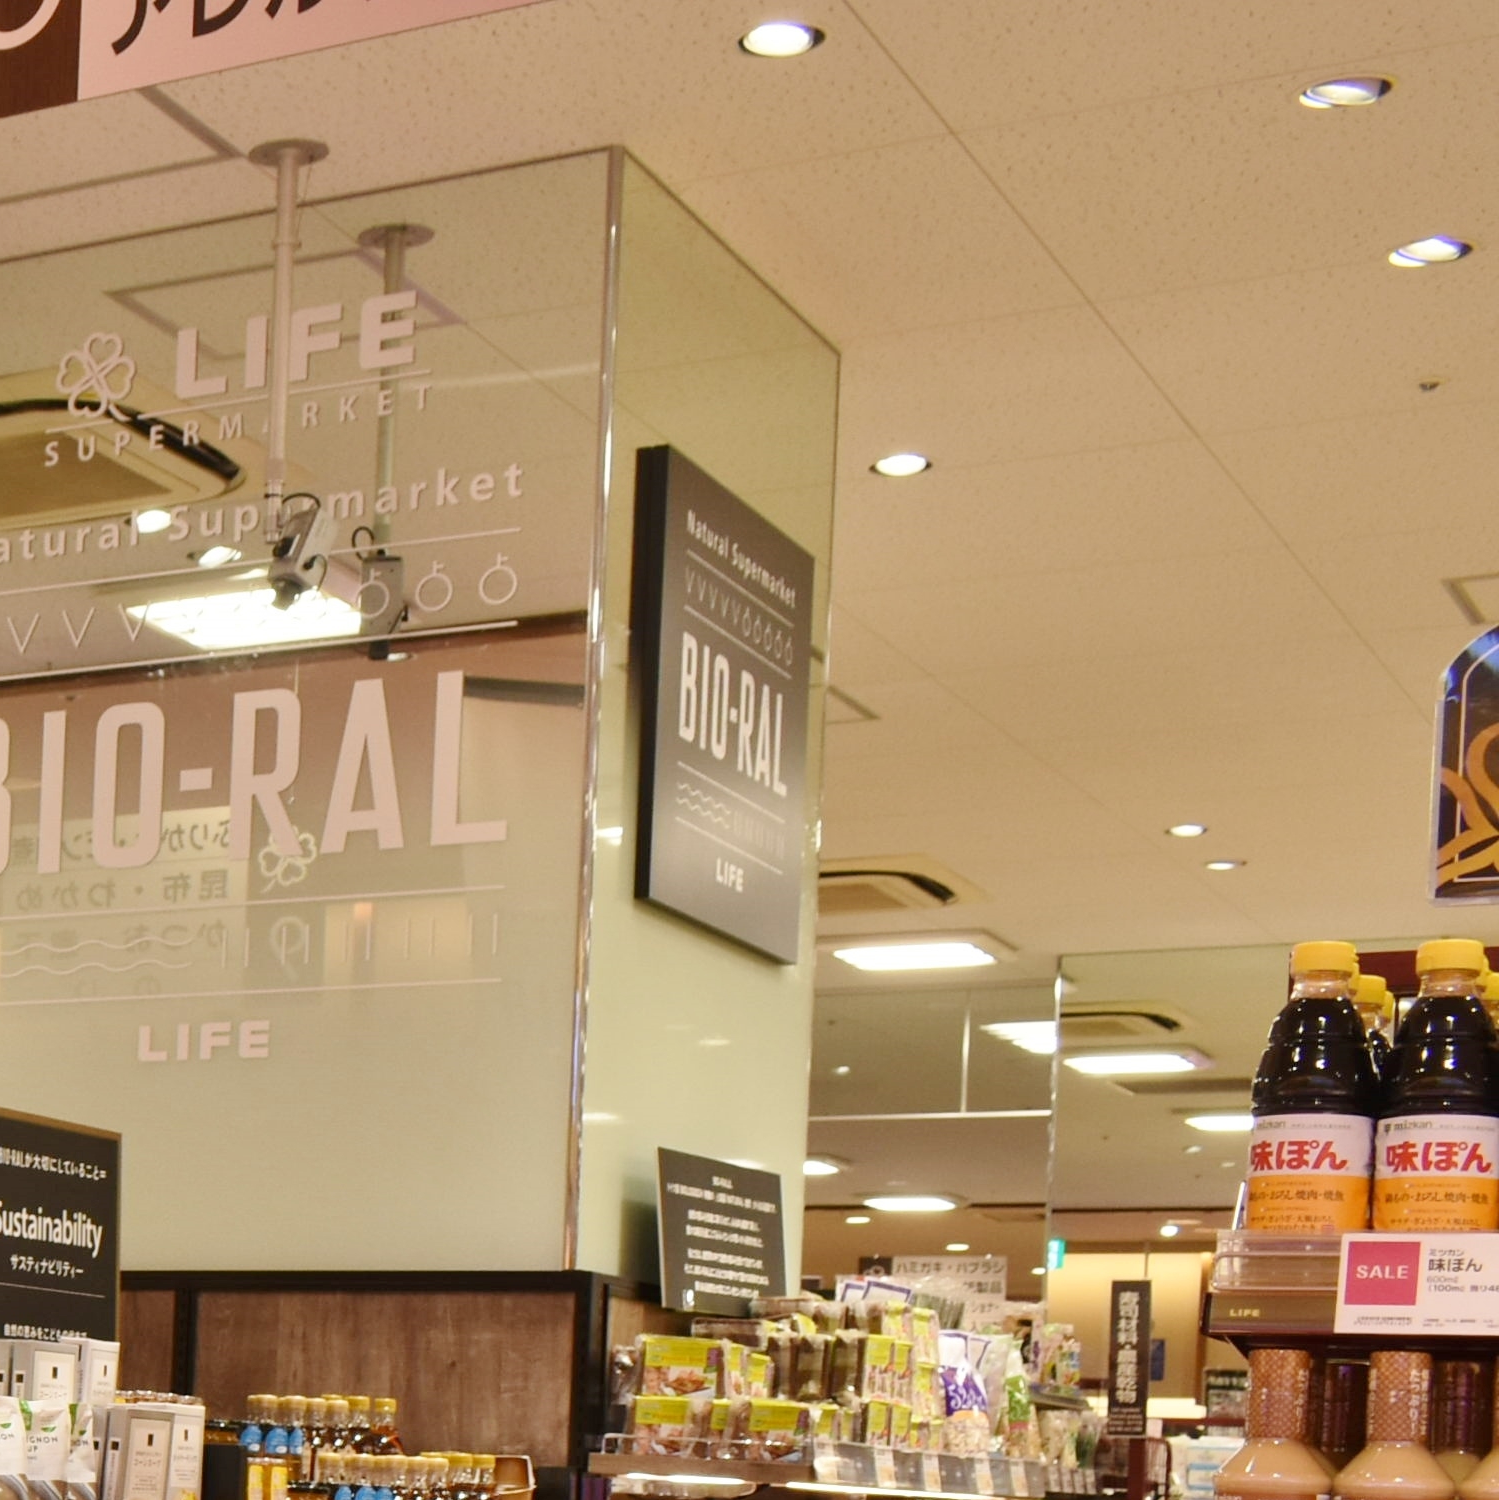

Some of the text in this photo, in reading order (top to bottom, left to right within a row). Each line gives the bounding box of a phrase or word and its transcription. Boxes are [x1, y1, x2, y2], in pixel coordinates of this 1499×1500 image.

[175, 290, 418, 399] LIFE
[44, 384, 434, 467] SUPERMRKET
[166, 462, 525, 542] Supmarket
[686, 509, 797, 608] Natural Supermarket
[678, 631, 788, 798] BIO-RAL
[715, 856, 744, 893] LIFE
[137, 1020, 271, 1063] LIFE
[1385, 1140, 1493, 1173] 味ぽん
[9, 1253, 85, 1280] サスティナビリティー
[1356, 1264, 1409, 1280] SALE
[1427, 1257, 1484, 1274] 味ぽん
[1229, 1308, 1261, 1318] LIFE
